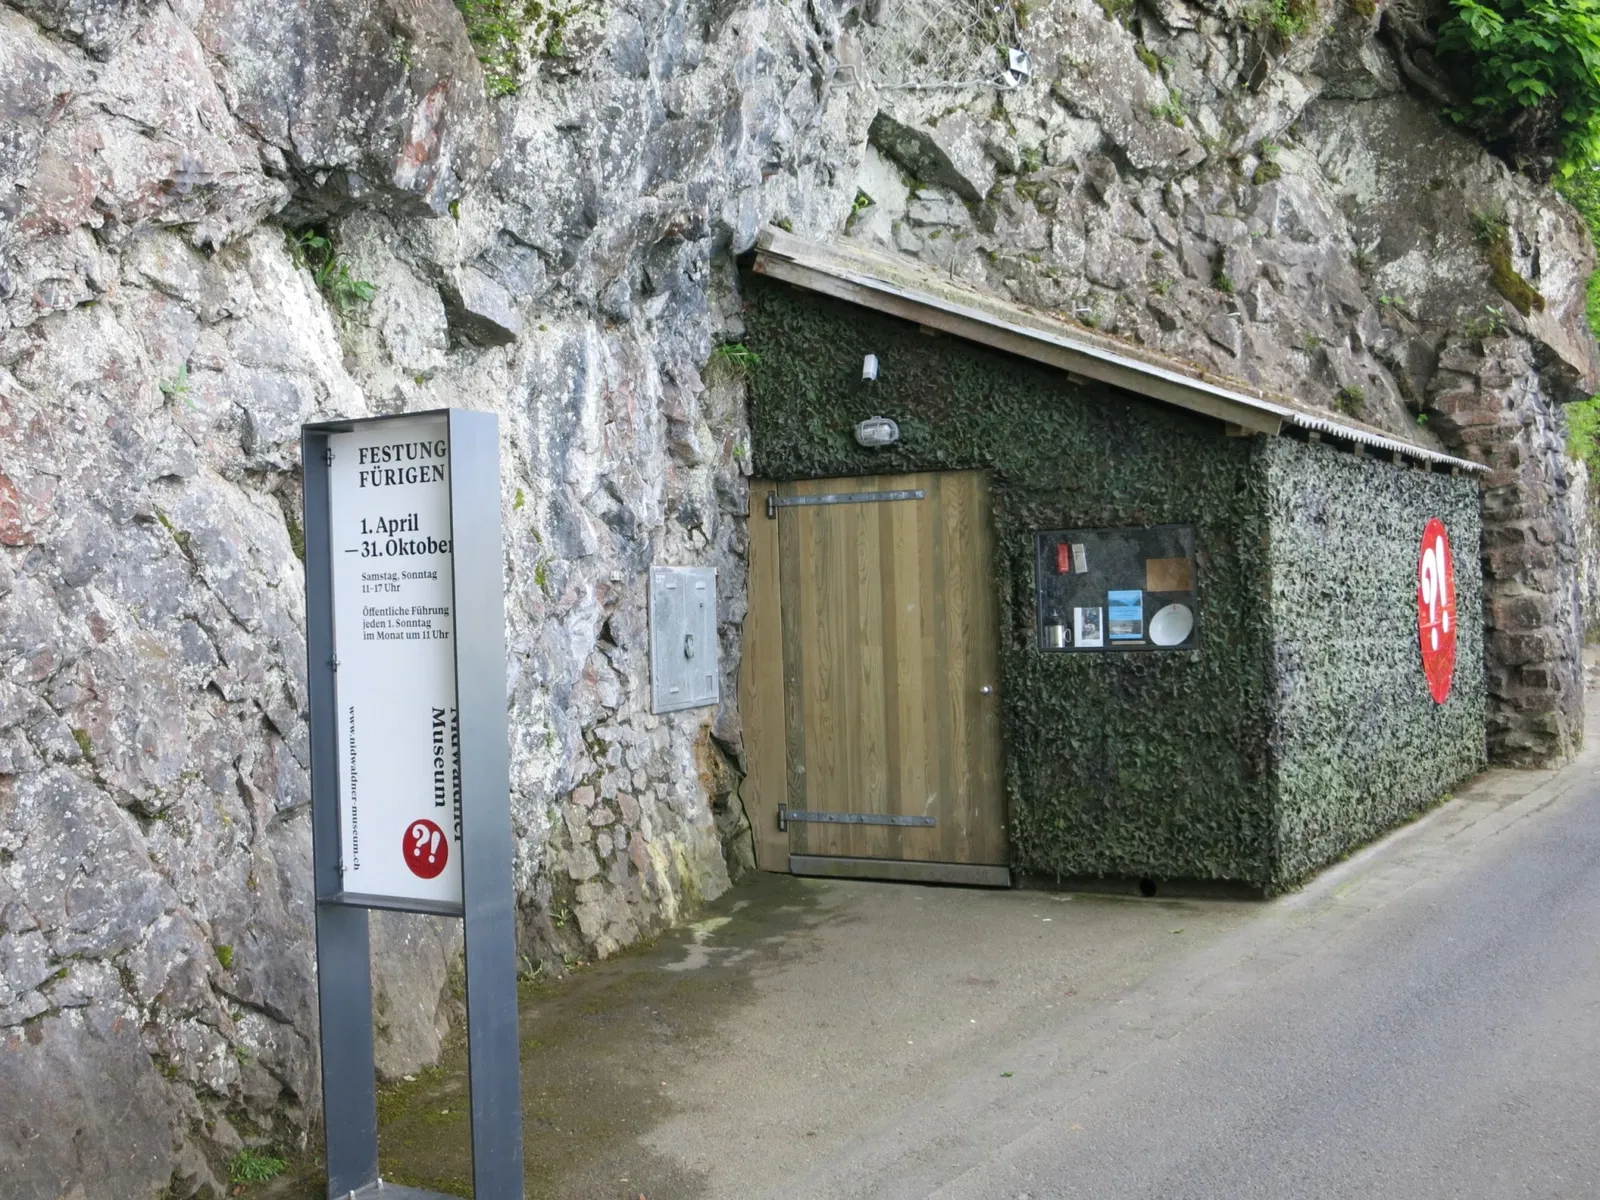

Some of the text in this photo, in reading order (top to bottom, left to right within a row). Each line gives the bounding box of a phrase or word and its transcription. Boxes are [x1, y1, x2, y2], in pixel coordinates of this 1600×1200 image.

[359, 440, 446, 464] FESTUNG
[359, 464, 444, 488] FÜRIGEN
[361, 513, 419, 537] 1. April
[362, 570, 438, 582] Samstag, Sonntag
[384, 582, 400, 592] Uhr
[362, 606, 450, 617] Öffentliche Führung
[362, 619, 386, 630] jeden
[396, 618, 432, 629] Sonntag
[363, 630, 450, 640] im Monat um 11 Uhr
[432, 706, 446, 808] Museum
[348, 706, 360, 870] www.nidwaldner-museum.ch
